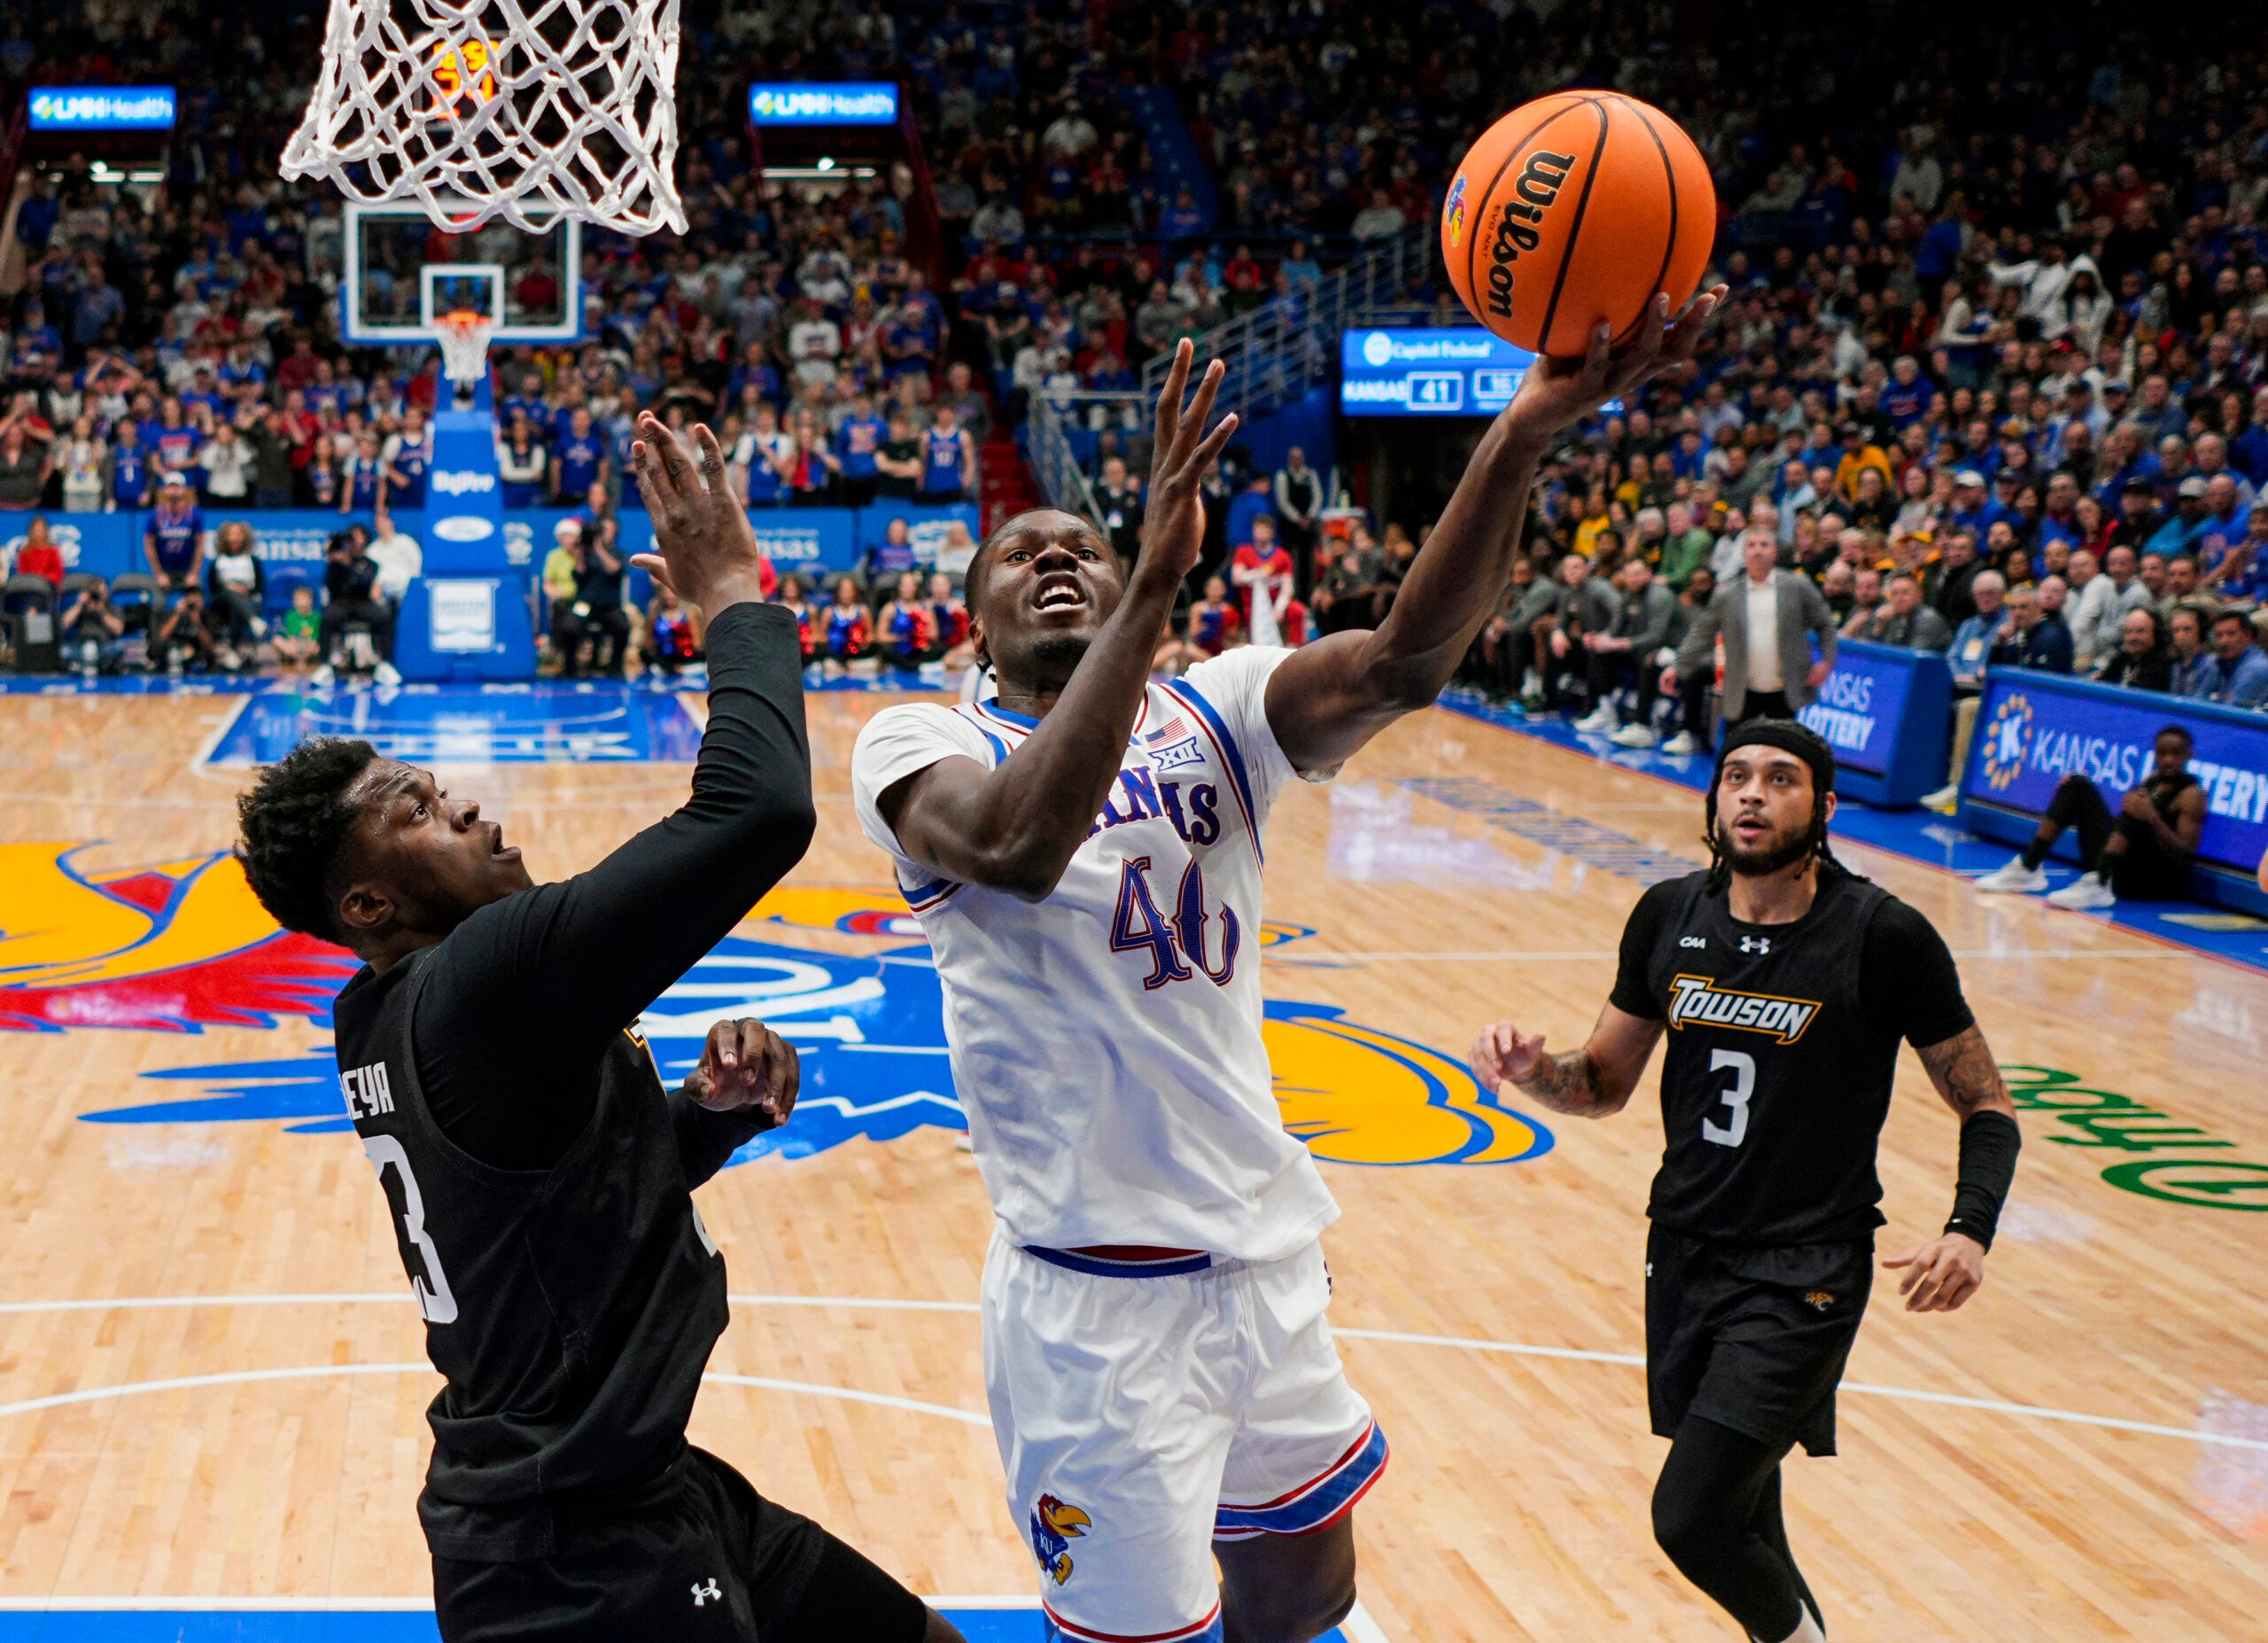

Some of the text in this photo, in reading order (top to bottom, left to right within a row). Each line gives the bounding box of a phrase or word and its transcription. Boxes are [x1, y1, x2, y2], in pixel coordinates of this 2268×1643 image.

[105, 97, 173, 118] Health
[827, 94, 894, 114] Health
[1488, 150, 1576, 319] Wilson
[1342, 380, 1449, 403] KANSAS 41
[2031, 728, 2139, 791] KANSAS
[1109, 856, 1240, 991] 40
[1679, 937, 1706, 949] CAA
[1702, 1047, 1757, 1149] 3
[1039, 1532, 1053, 1555] KU
